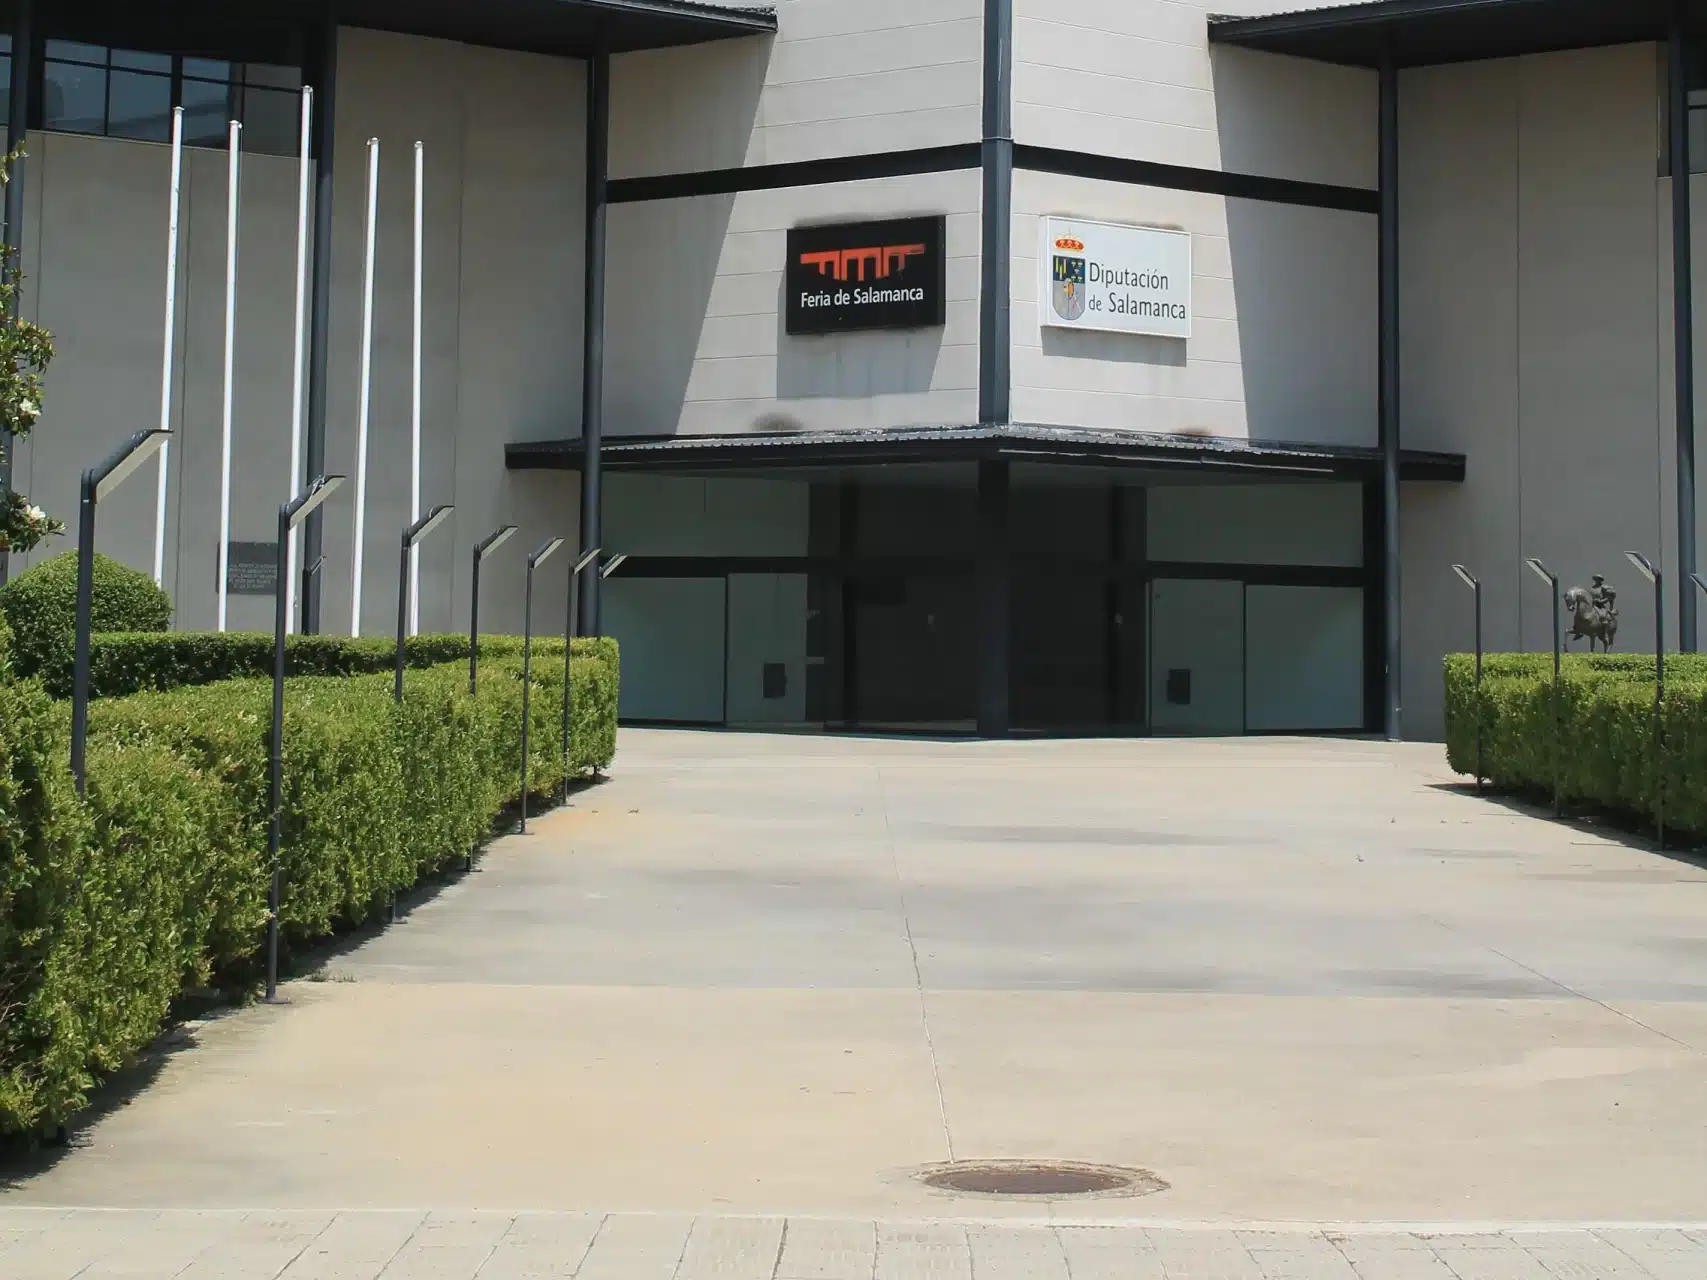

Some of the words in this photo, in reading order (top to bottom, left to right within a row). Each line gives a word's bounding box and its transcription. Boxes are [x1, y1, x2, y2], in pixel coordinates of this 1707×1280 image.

[1089, 262, 1169, 290] Diputación
[801, 292, 831, 308] Feria
[834, 288, 851, 306] de
[853, 286, 924, 304] Salamanca
[1088, 294, 1102, 311] de
[1108, 292, 1186, 319] Salamanca
